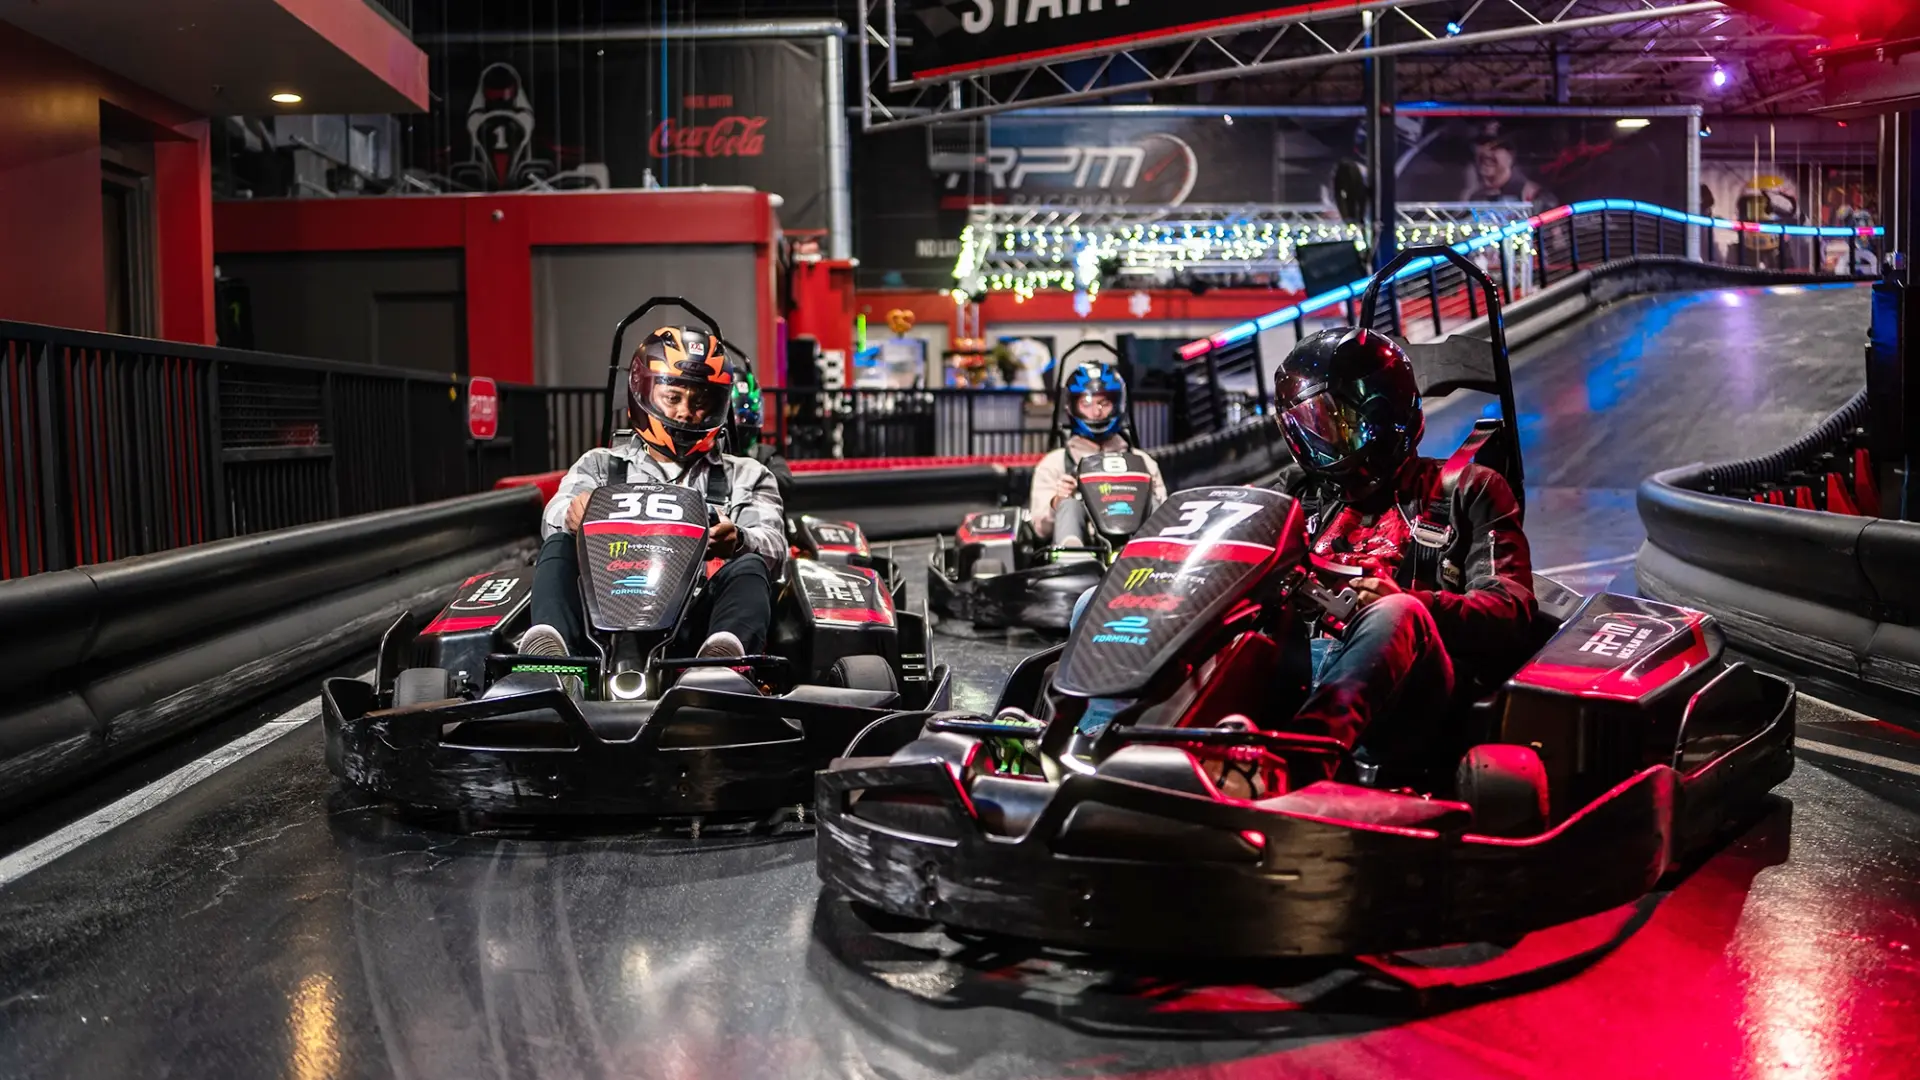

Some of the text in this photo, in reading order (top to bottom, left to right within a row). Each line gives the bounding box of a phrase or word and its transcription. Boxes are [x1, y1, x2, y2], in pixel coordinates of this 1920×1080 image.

[493, 126, 508, 149] 1
[945, 147, 1145, 189] RPM
[608, 492, 684, 521] 36
[1159, 500, 1265, 537] 37
[628, 543, 675, 554] MONSTER
[1149, 571, 1206, 585] MONTER
[1578, 622, 1637, 656] RPM
